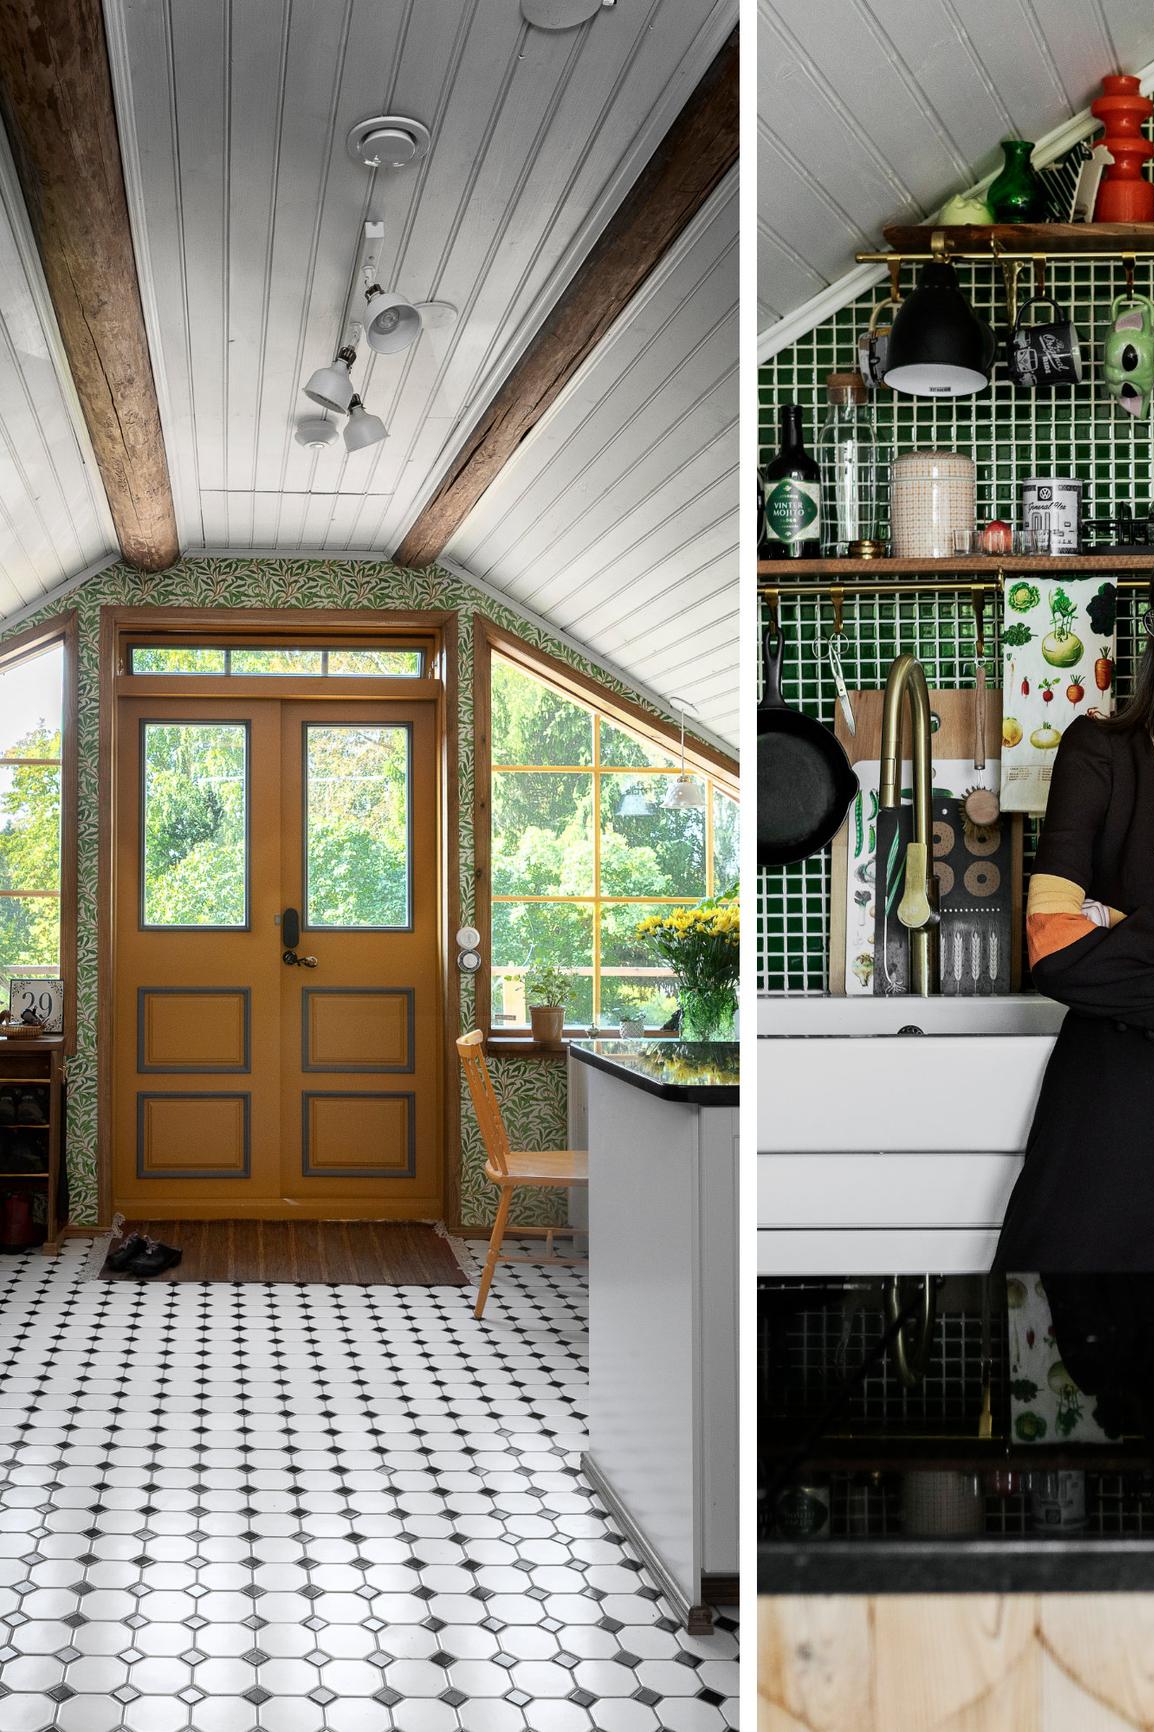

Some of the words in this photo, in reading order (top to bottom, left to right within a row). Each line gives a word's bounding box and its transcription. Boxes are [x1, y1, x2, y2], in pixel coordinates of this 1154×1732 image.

[1041, 333, 1071, 371] Original
[772, 509, 805, 517] MOJITO
[22, 991, 53, 1019] 29
